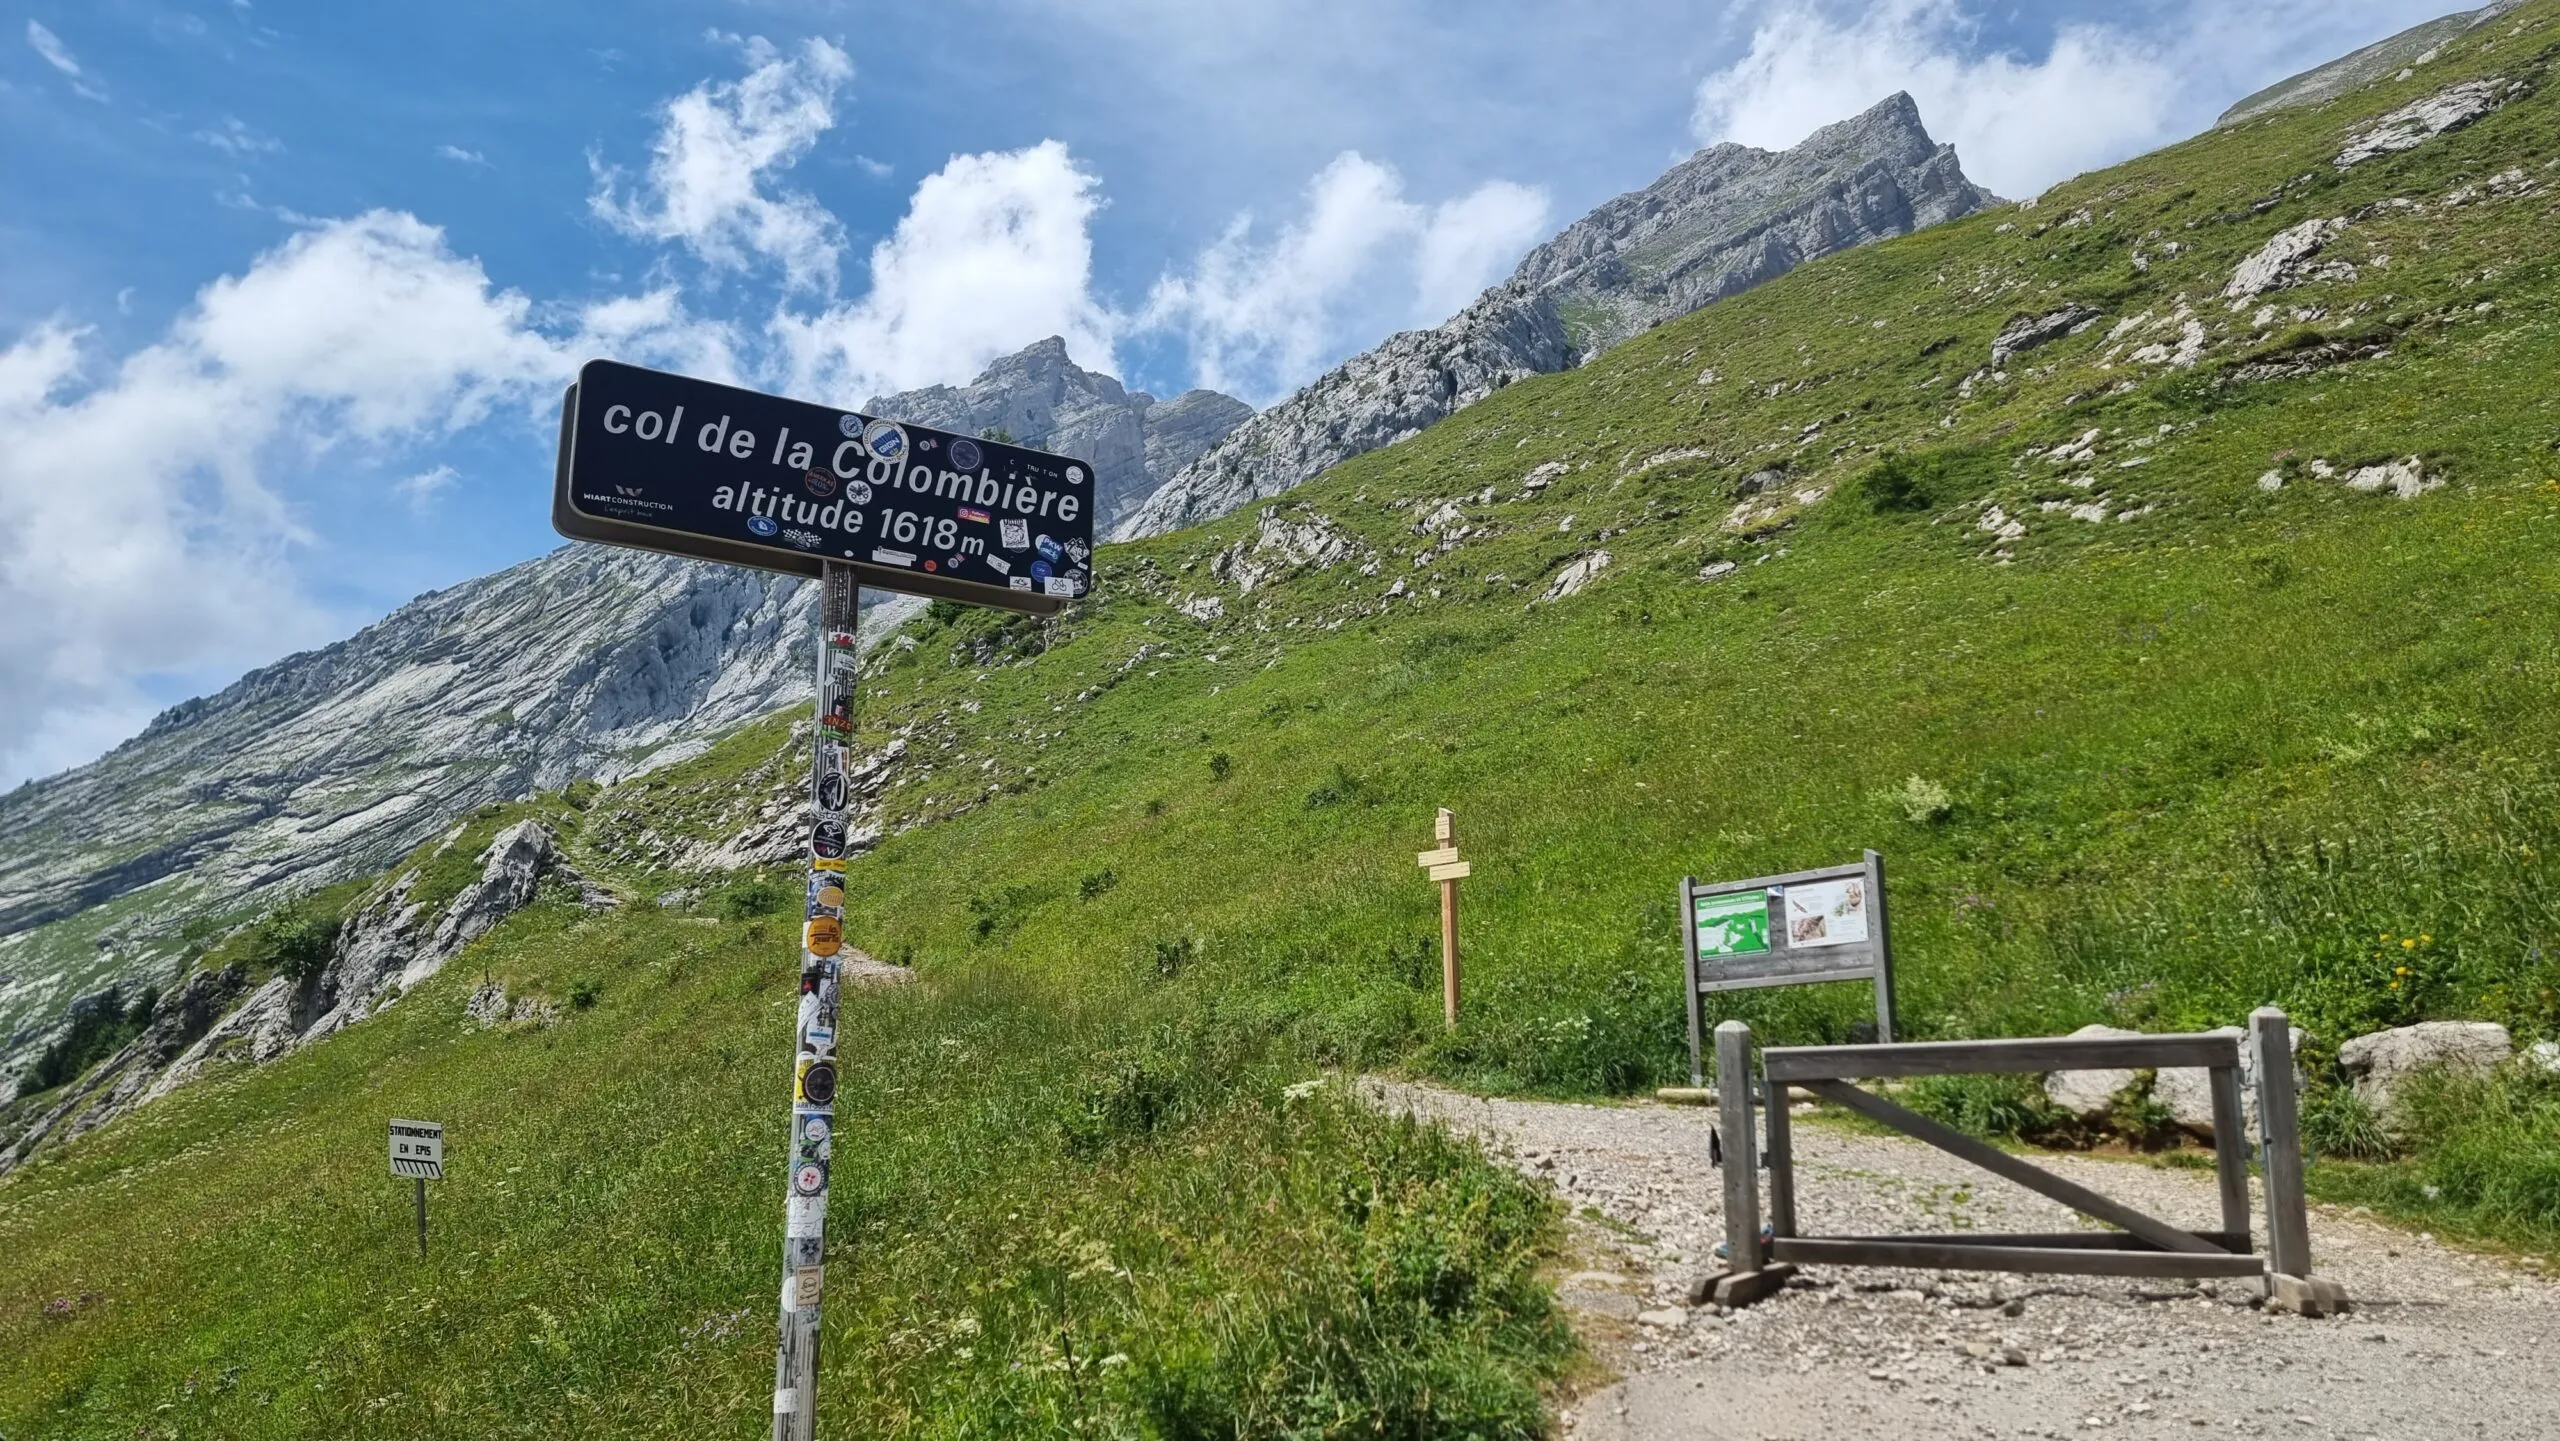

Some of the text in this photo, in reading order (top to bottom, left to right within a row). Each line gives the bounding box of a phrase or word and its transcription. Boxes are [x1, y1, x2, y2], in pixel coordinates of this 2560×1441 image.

[603, 404, 684, 444] col
[697, 415, 756, 459] de
[771, 427, 814, 471] la
[832, 440, 1080, 522] Colombière
[711, 481, 864, 534] altitude
[390, 1126, 442, 1140] STATIONNEMENT
[400, 1143, 431, 1156] EN EPIS
